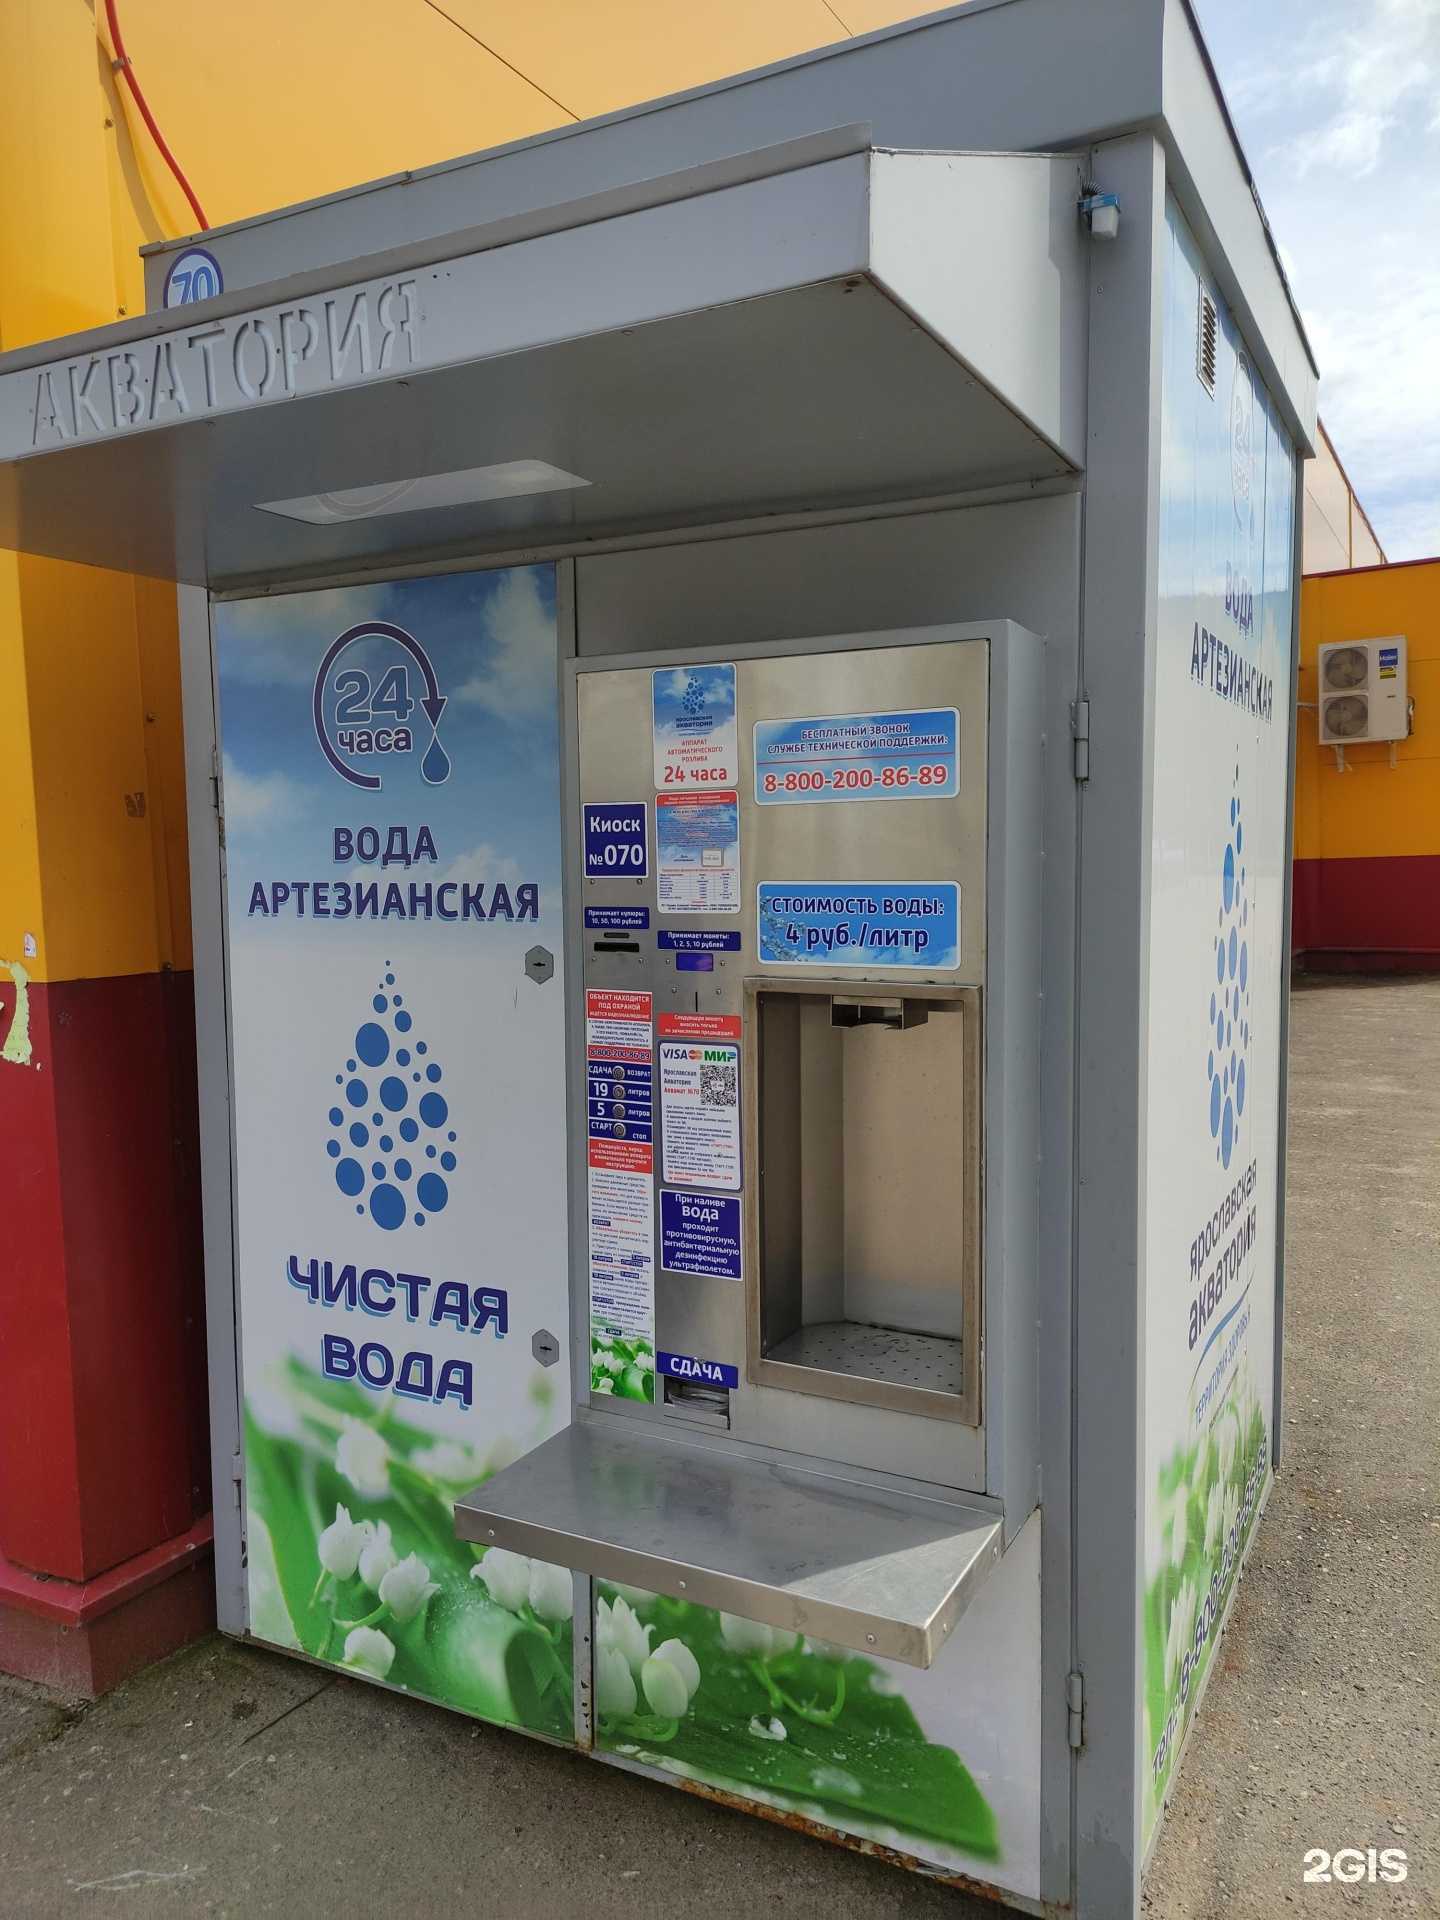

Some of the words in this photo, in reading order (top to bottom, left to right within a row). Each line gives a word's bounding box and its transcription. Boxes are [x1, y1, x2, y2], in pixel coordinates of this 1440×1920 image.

[171, 266, 212, 306] 70
[32, 279, 418, 446] АКВАТОРИЯ
[1225, 560, 1254, 640] ВОДА
[1190, 621, 1273, 727] АРТЕЗИАНСКАЯ
[334, 665, 414, 725] 24
[801, 726, 867, 740] БЕСПЛАТНЫЙ
[869, 723, 909, 736] ЗВОНОК
[337, 726, 413, 755] часа
[767, 742, 807, 755] СЛУЖБЕ
[808, 737, 876, 752] ТЕХНИЧЕСКОЙ
[879, 734, 948, 748] ПОДДЕРЖКИ:
[667, 746, 723, 756] АВТОМАТИЧЕСКОГО
[664, 766, 686, 783] 24
[690, 767, 728, 781] часа
[763, 764, 948, 794] 8-800-200-86-89
[589, 816, 641, 833] Киоск
[333, 825, 439, 868] ВОДА
[248, 881, 539, 922] АРТЕЗИАНСКАЯ
[771, 897, 878, 915] СТОИМОСТЬ
[883, 898, 945, 916] ВОДЫ:
[588, 909, 620, 917] Принимает
[621, 918, 643, 927] рублей
[667, 931, 702, 942] Принимает
[701, 940, 724, 950] рублей
[785, 924, 799, 944] 4
[806, 922, 929, 953] руб./литр
[612, 1003, 641, 1011] ОХРАНОЙ
[613, 994, 650, 1003] НАХОДИТСЯ
[662, 1048, 688, 1060] VISA
[704, 1050, 737, 1062] МИР
[588, 1065, 612, 1075] СДАЧА
[627, 1069, 651, 1077] ВОЗВРАТ
[593, 1082, 609, 1097] 19
[627, 1088, 650, 1097] литров
[597, 1102, 605, 1116] 5
[627, 1109, 650, 1118] литров
[591, 1121, 612, 1131] СТАРТ
[675, 1193, 692, 1205] При
[694, 1197, 726, 1208] наливе
[682, 1222, 719, 1233] проходит
[1189, 1157, 1257, 1282] ярославская
[666, 1230, 737, 1247] противовирусную,
[663, 1240, 740, 1257] антибактериальную
[675, 1251, 728, 1265] дезинфекцию
[669, 1260, 735, 1276] ультрафиолетом.
[1188, 1203, 1257, 1351] акватория
[287, 1255, 508, 1339] ЧИСТАЯ
[321, 1333, 473, 1411] ВОДА
[670, 1357, 723, 1381] СДАЧА
